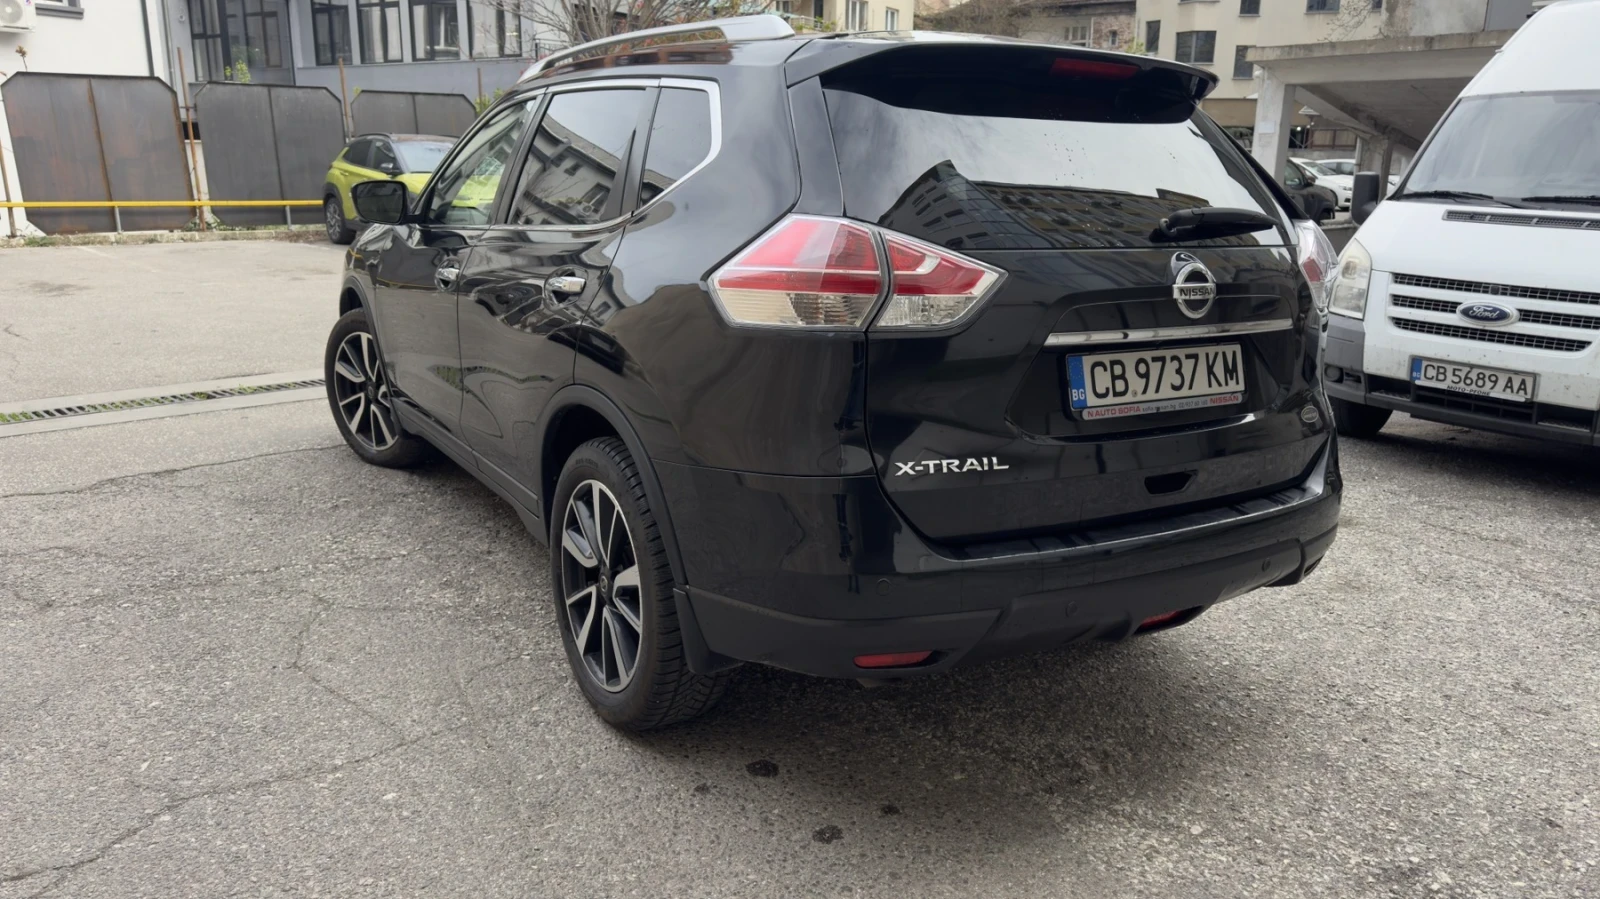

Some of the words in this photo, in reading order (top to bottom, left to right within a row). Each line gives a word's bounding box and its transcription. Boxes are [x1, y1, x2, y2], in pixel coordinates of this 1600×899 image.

[1180, 287, 1214, 297] NISSAN
[1469, 305, 1500, 319] Ford
[1090, 359, 1129, 399] CB
[1134, 353, 1199, 395] 9737
[1205, 350, 1240, 388] KM
[1423, 364, 1447, 382] CB
[1451, 367, 1499, 390] 5689
[1502, 376, 1528, 395] AA
[1072, 388, 1085, 401] BG
[1095, 408, 1117, 417] AUTO
[1118, 405, 1141, 415] SOFIA
[1210, 395, 1239, 405] NISSAN
[894, 456, 1009, 476] X-TRAIL
